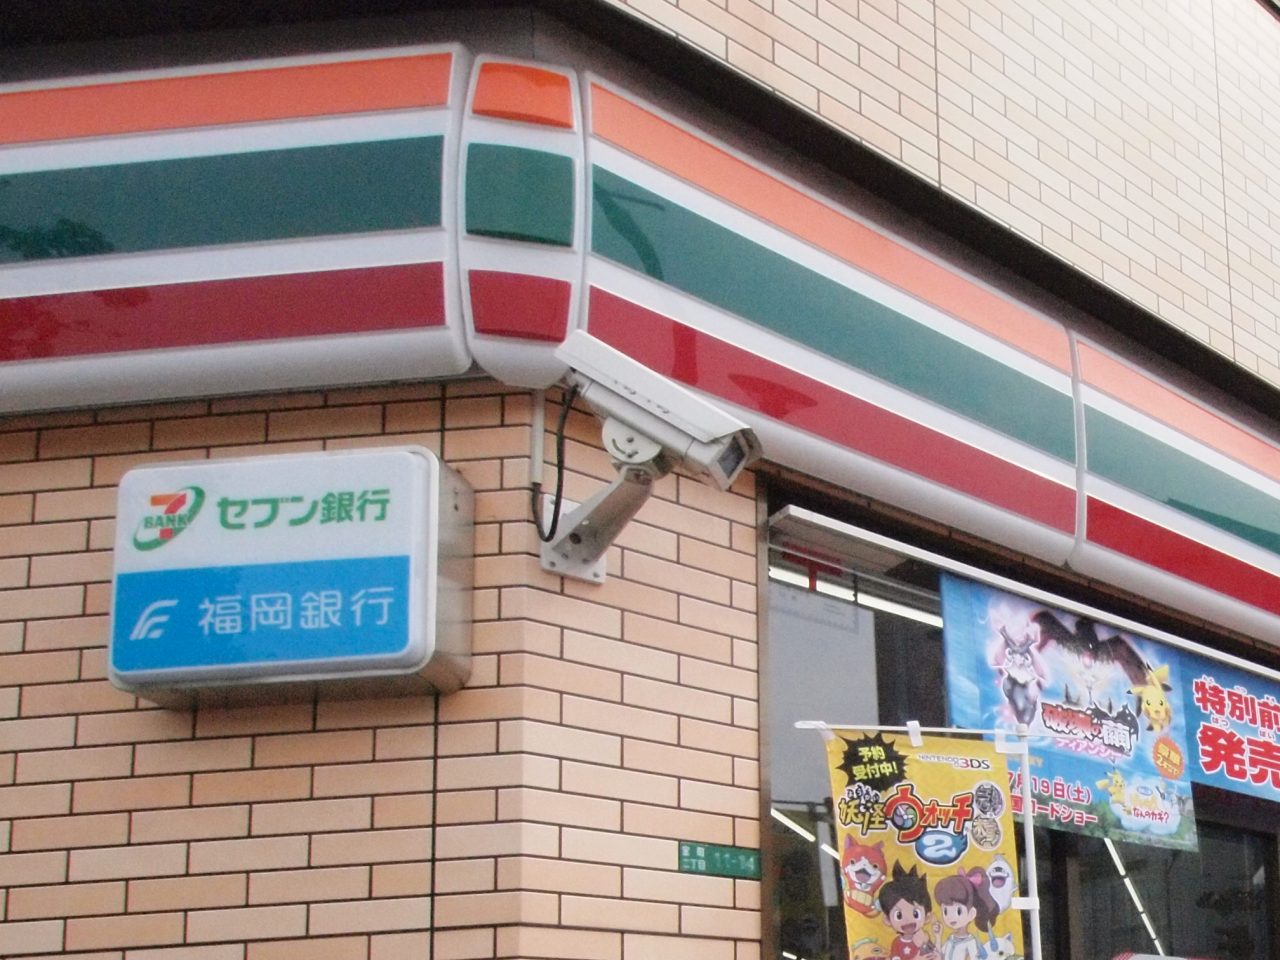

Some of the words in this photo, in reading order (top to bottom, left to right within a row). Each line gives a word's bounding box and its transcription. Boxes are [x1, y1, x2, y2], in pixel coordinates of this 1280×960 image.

[216, 488, 391, 530] セブン銀行
[143, 513, 190, 530] BANK
[198, 586, 395, 636] 福岡銀行
[857, 746, 886, 762] 予約
[960, 757, 991, 770] 3DS
[852, 762, 899, 781] 受付中!
[919, 833, 958, 859] 2
